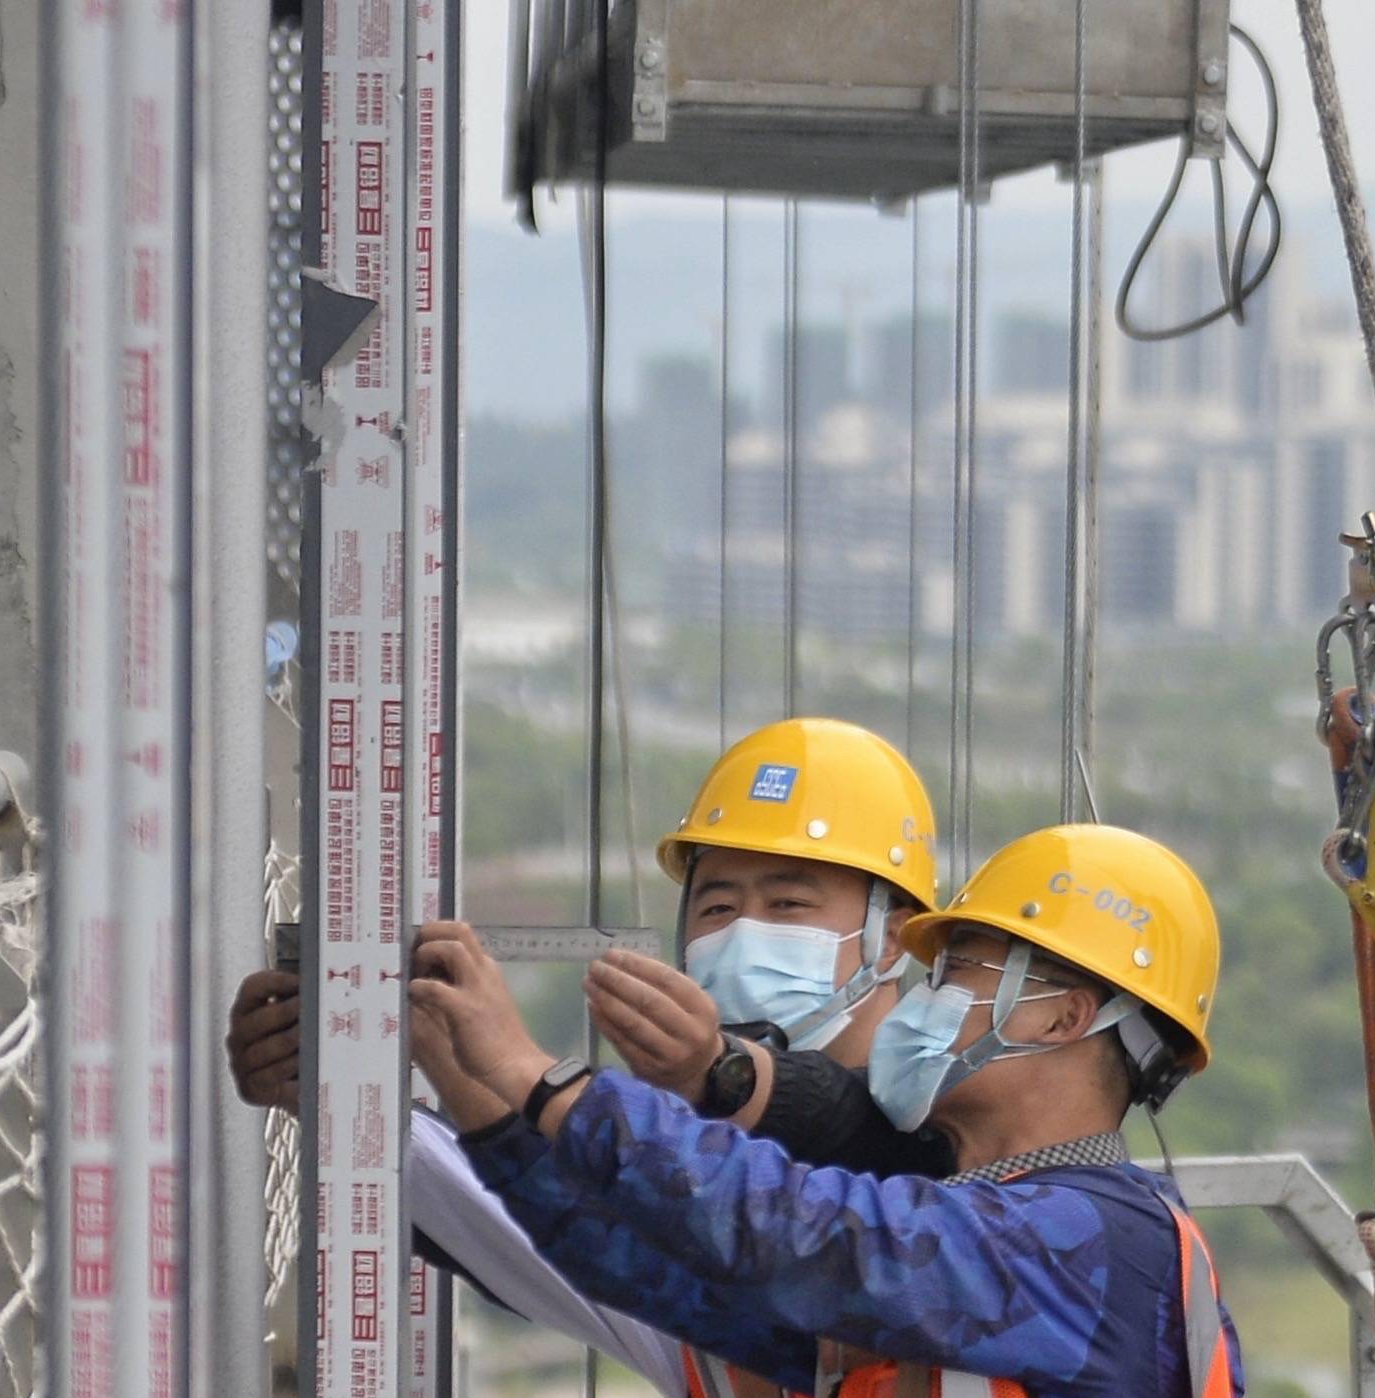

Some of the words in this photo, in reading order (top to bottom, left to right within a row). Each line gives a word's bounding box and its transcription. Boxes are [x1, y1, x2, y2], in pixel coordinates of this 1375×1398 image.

[358, 142, 381, 234] 三星铝材
[330, 701, 352, 789] 三星铝材
[327, 799, 342, 942] 铝型材国家标准起草单位
[380, 800, 394, 944] 铝型材国家标准起草单位
[1048, 871, 1153, 933] C-002
[75, 1168, 111, 1297] 三星铝材
[354, 1252, 376, 1340] 三星铝材
